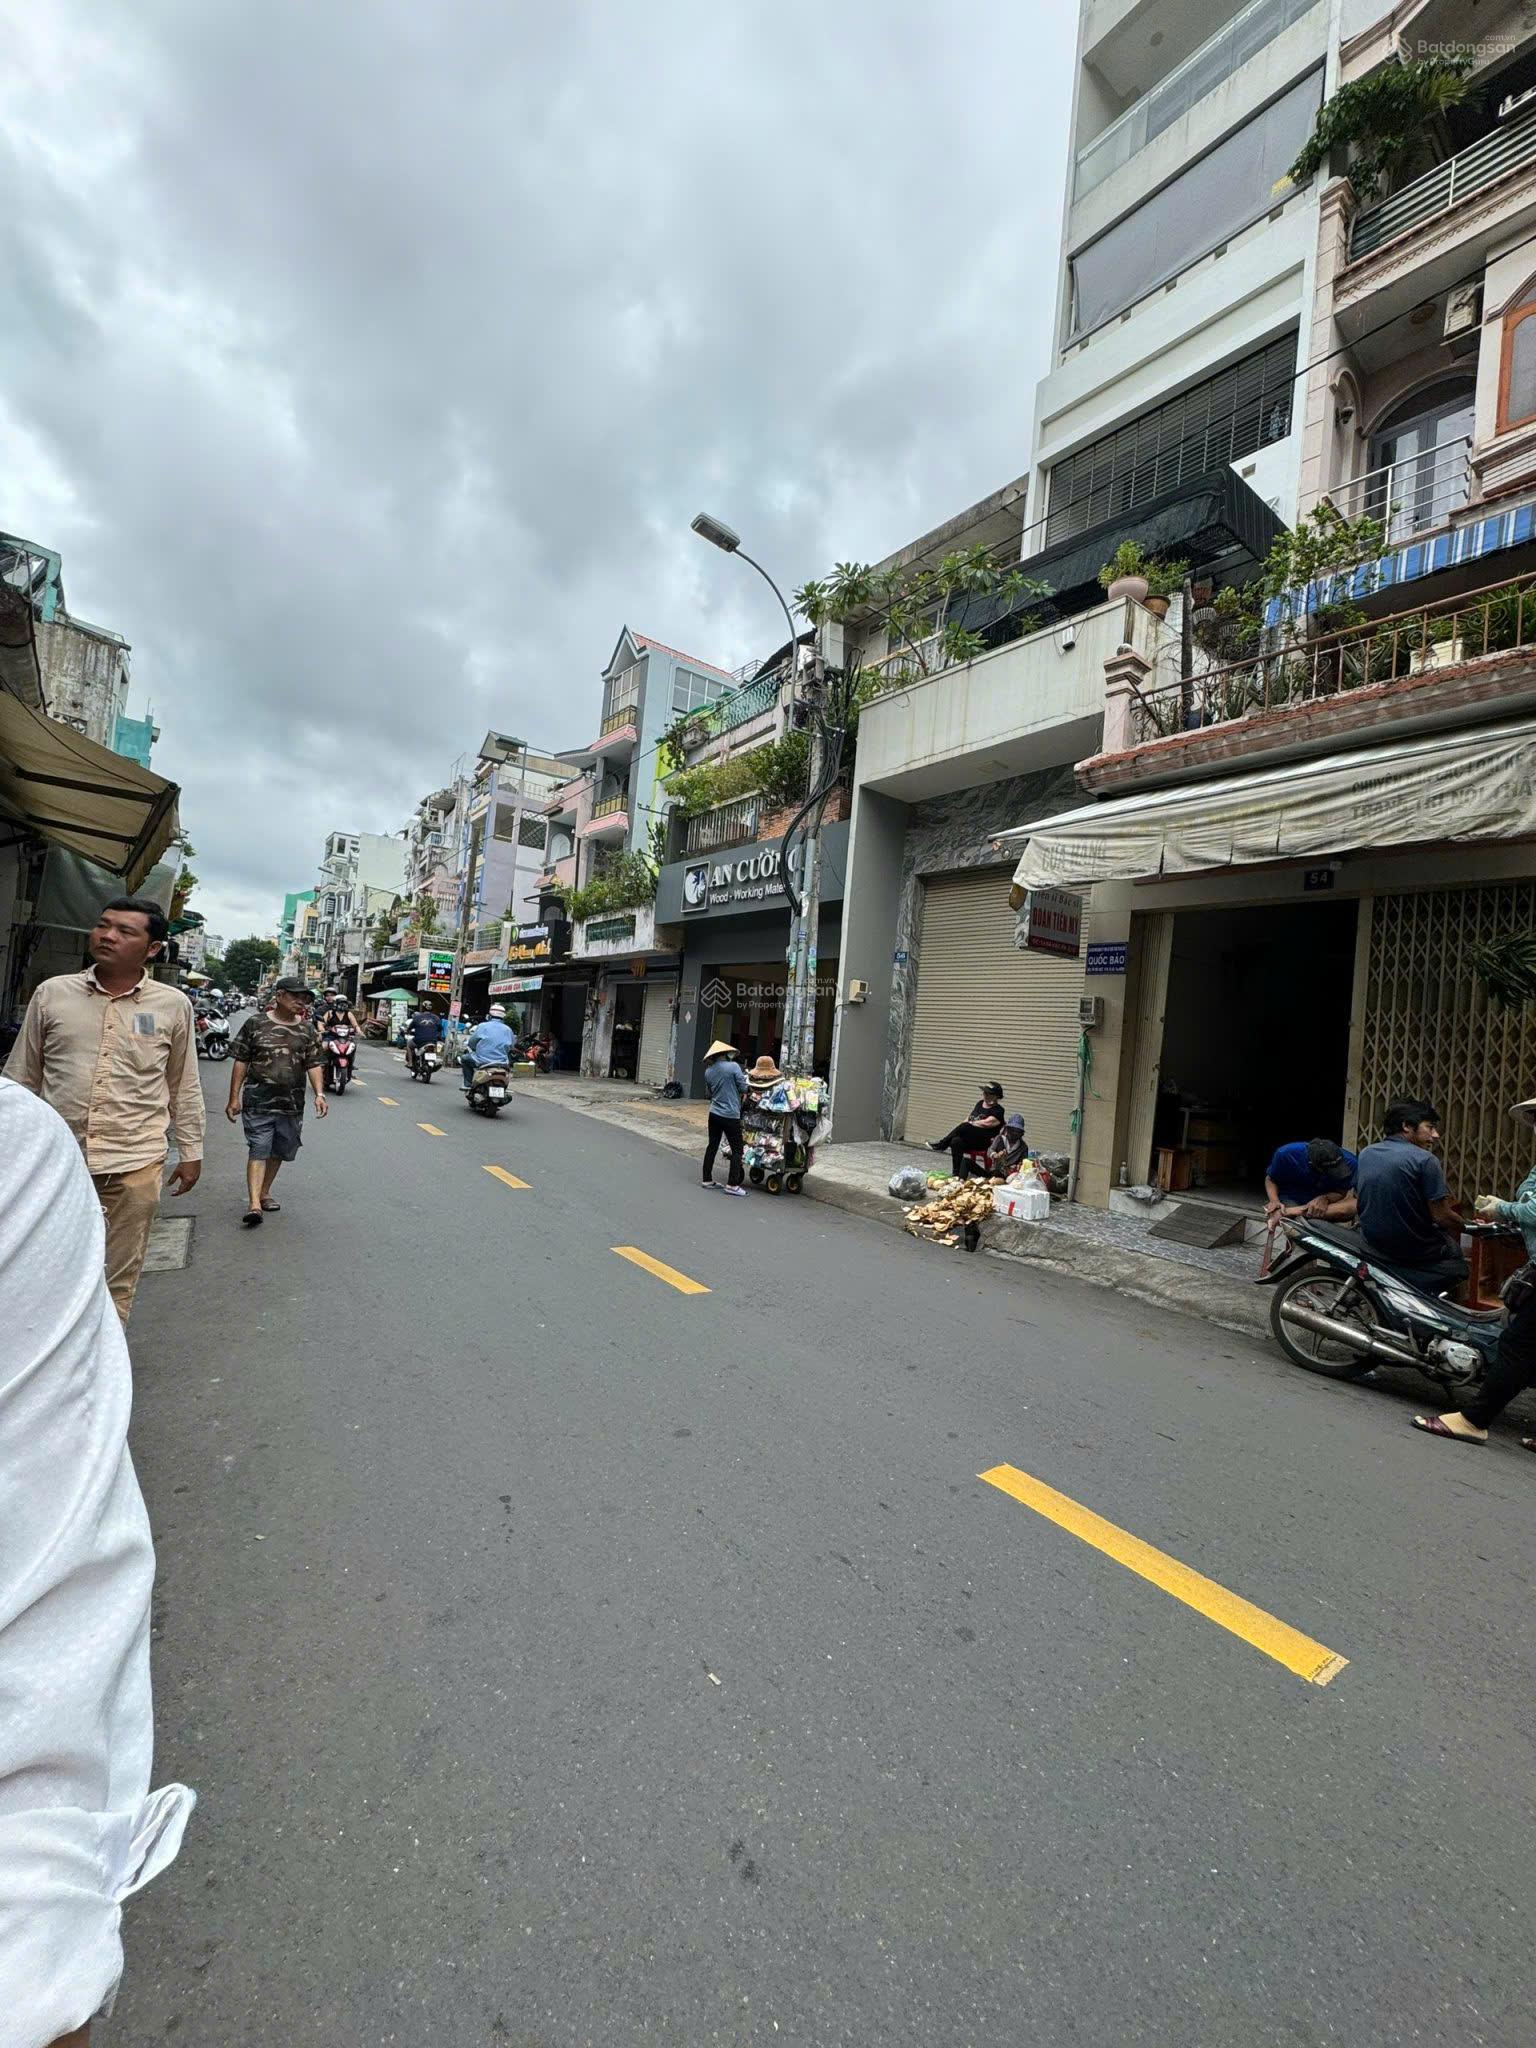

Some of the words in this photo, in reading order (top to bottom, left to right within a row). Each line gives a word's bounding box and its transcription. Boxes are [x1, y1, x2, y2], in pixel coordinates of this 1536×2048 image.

[710, 863, 733, 888] AN
[1310, 871, 1328, 884] 54
[709, 892, 728, 905] Wood
[733, 885, 763, 901] Working
[1088, 952, 1108, 966] QUỐC
[1109, 952, 1125, 965] BẢO
